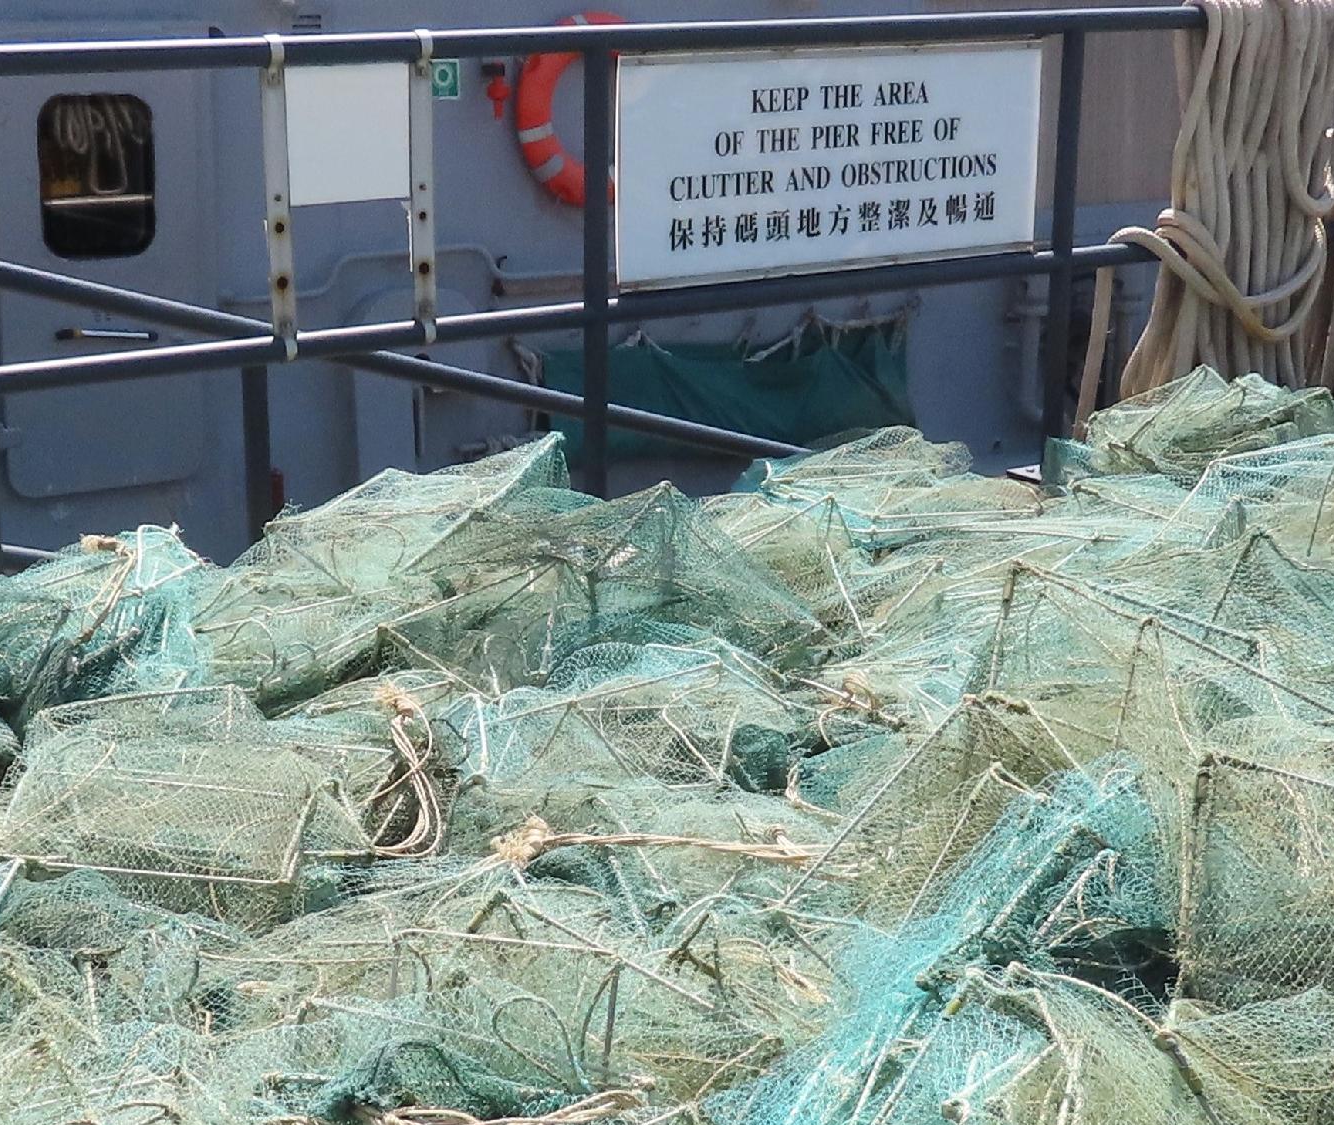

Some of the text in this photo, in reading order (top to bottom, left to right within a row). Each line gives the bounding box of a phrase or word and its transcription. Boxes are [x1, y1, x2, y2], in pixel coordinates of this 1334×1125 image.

[751, 81, 929, 113] KEEP THE AREA
[715, 116, 961, 157] OF THE PIER FREE OF
[669, 153, 997, 201] CLUTTER AND OBSTRUCTIONS
[669, 191, 996, 251] 保持碼頭地方整潔及暢通
